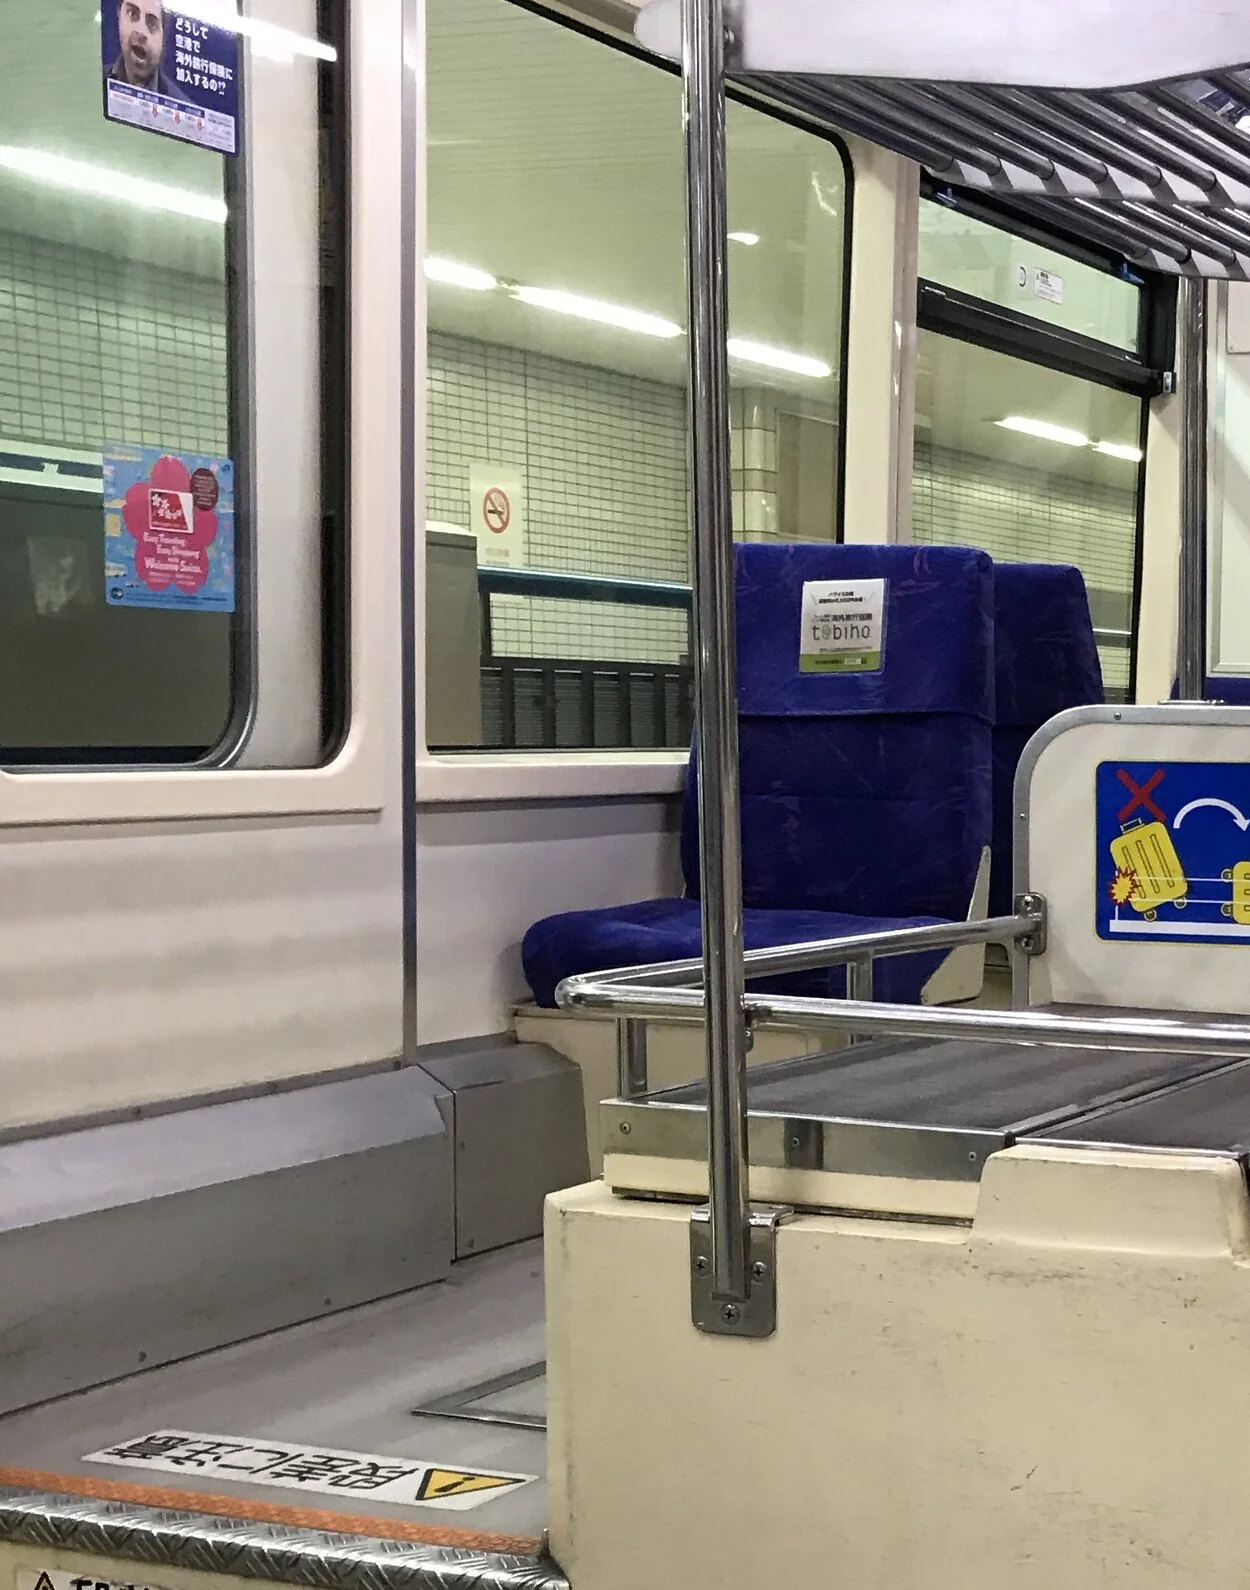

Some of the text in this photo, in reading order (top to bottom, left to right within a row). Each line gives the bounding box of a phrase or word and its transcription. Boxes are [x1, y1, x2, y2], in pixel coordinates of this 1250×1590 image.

[175, 18, 209, 40] どうして
[175, 34, 201, 52] 空港で
[175, 50, 233, 81] 海外旅行保険に
[103, 1435, 419, 1490] 段差に注意
